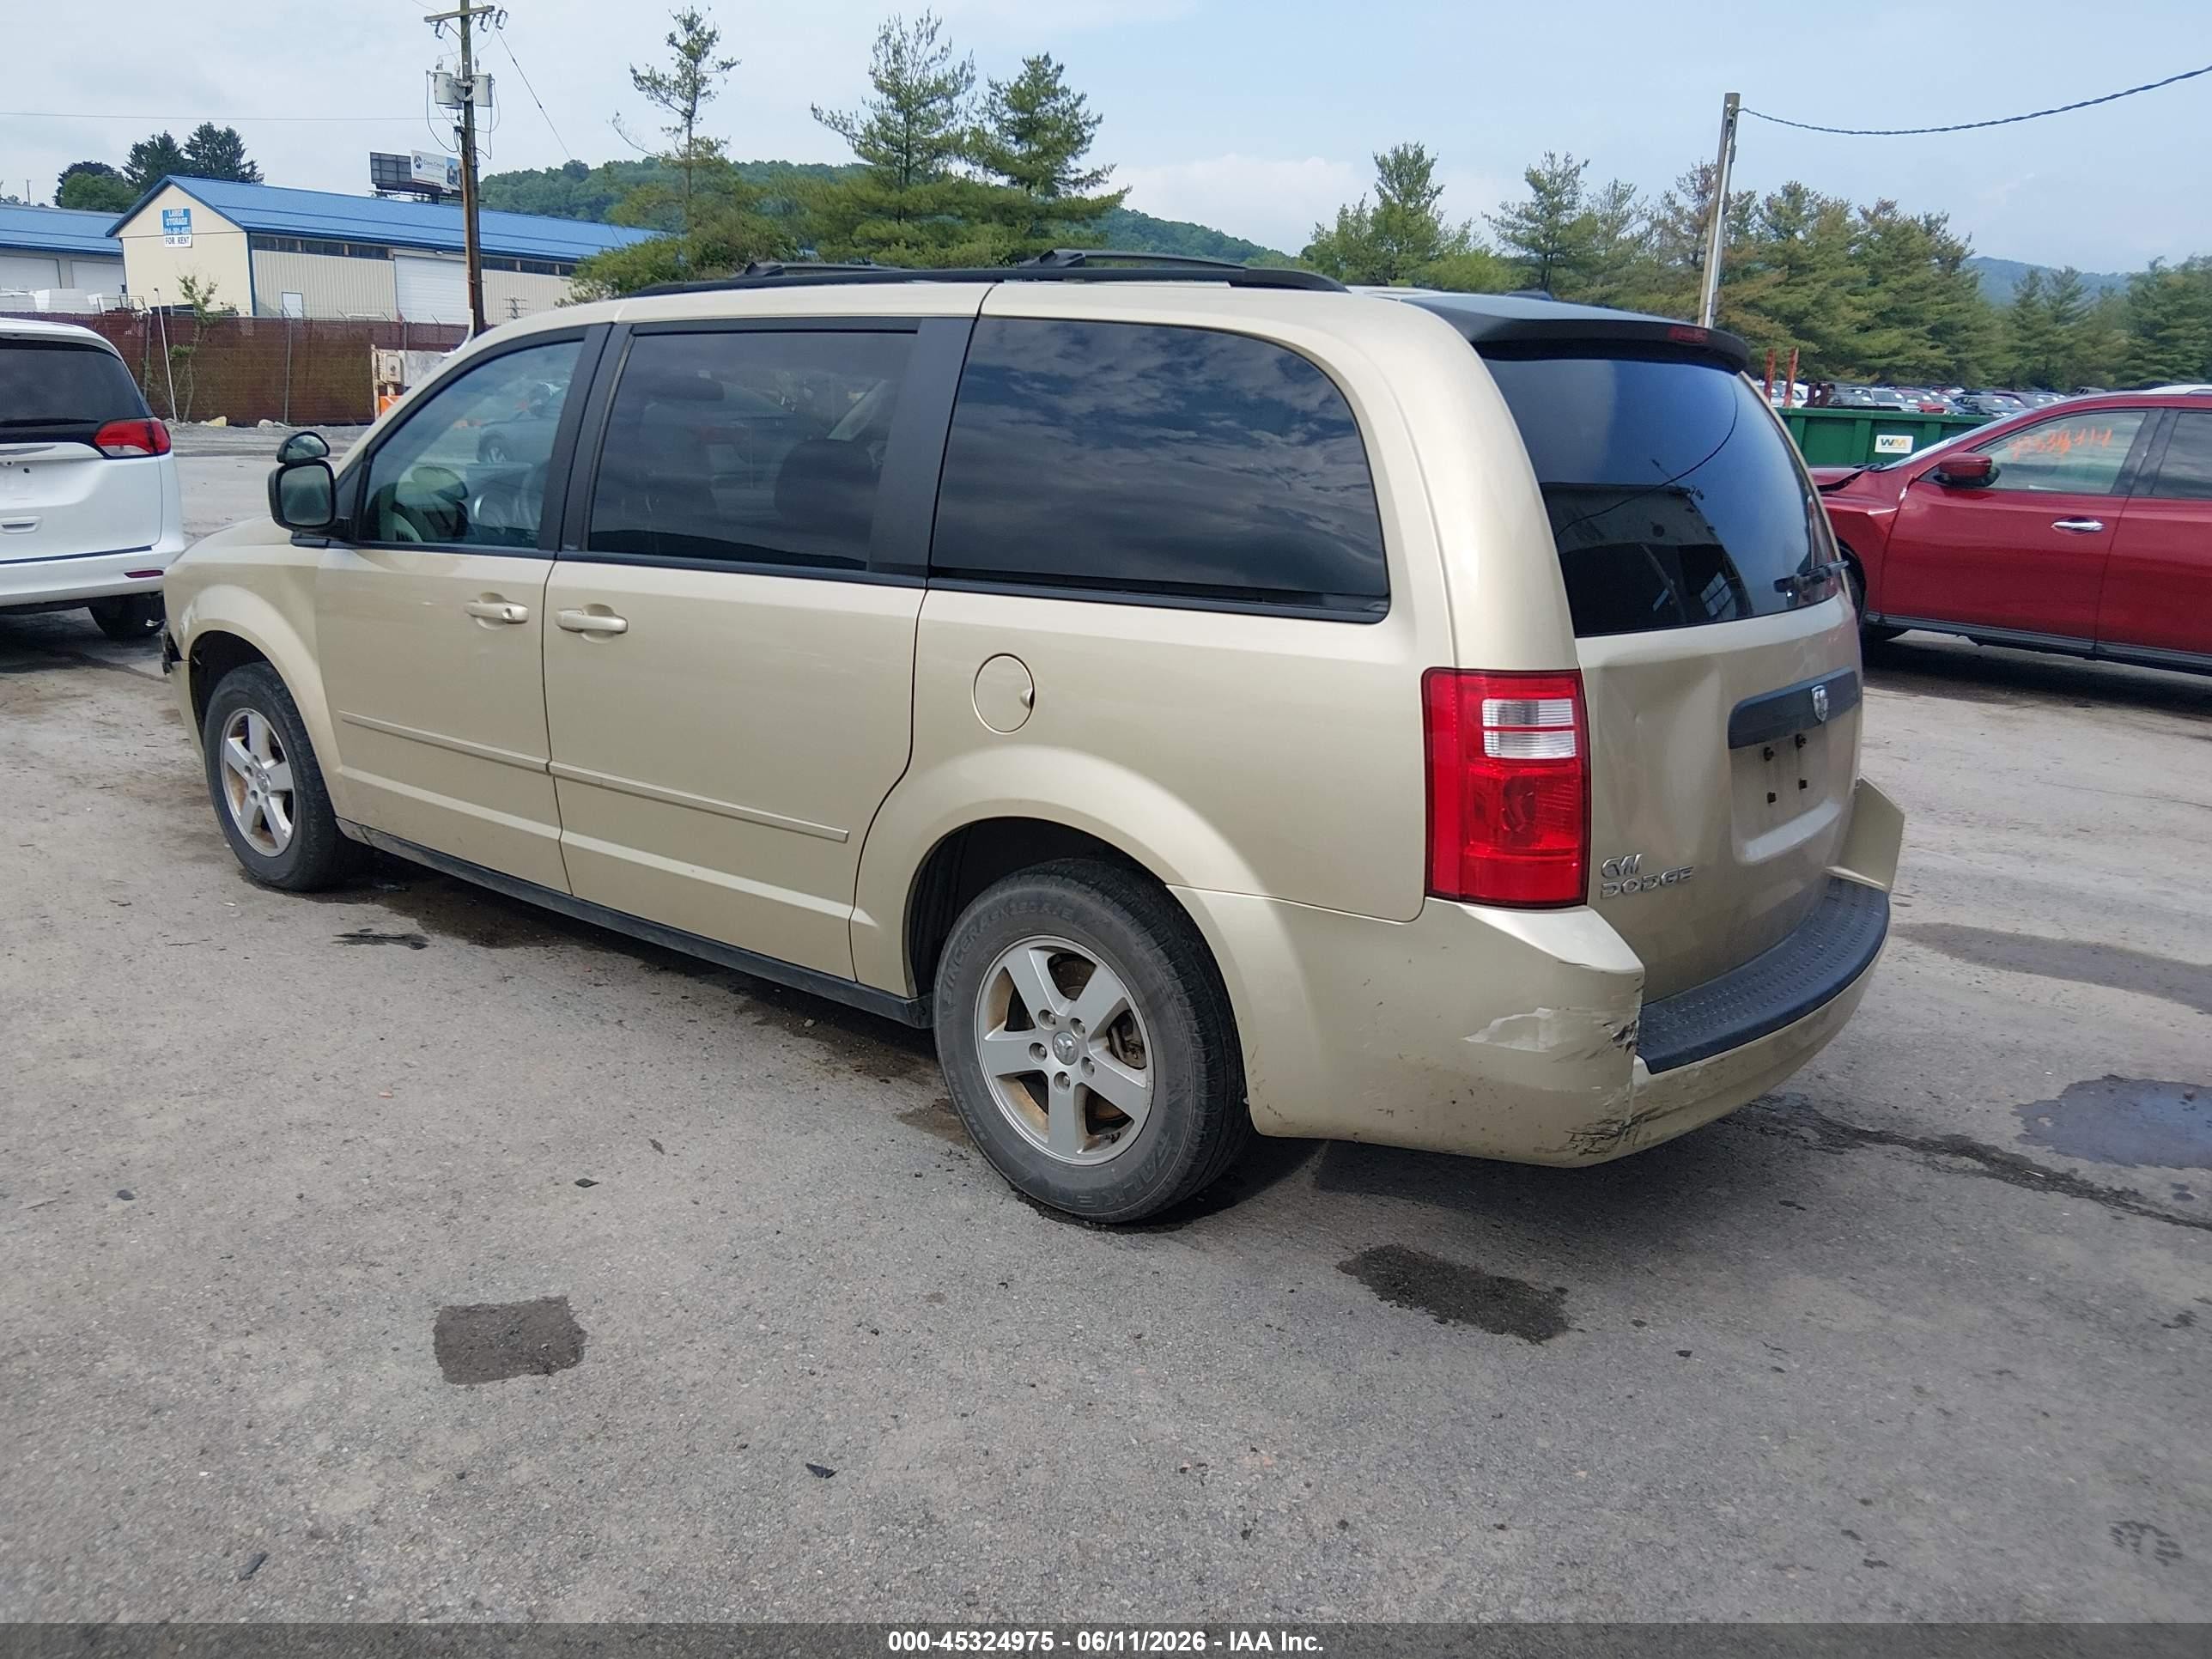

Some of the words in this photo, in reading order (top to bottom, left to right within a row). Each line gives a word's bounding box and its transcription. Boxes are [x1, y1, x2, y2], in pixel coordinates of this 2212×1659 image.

[166, 217, 188, 226] STORAGE
[166, 236, 175, 245] FOR
[178, 236, 190, 245] RENT
[1601, 866, 1693, 899] DODGE
